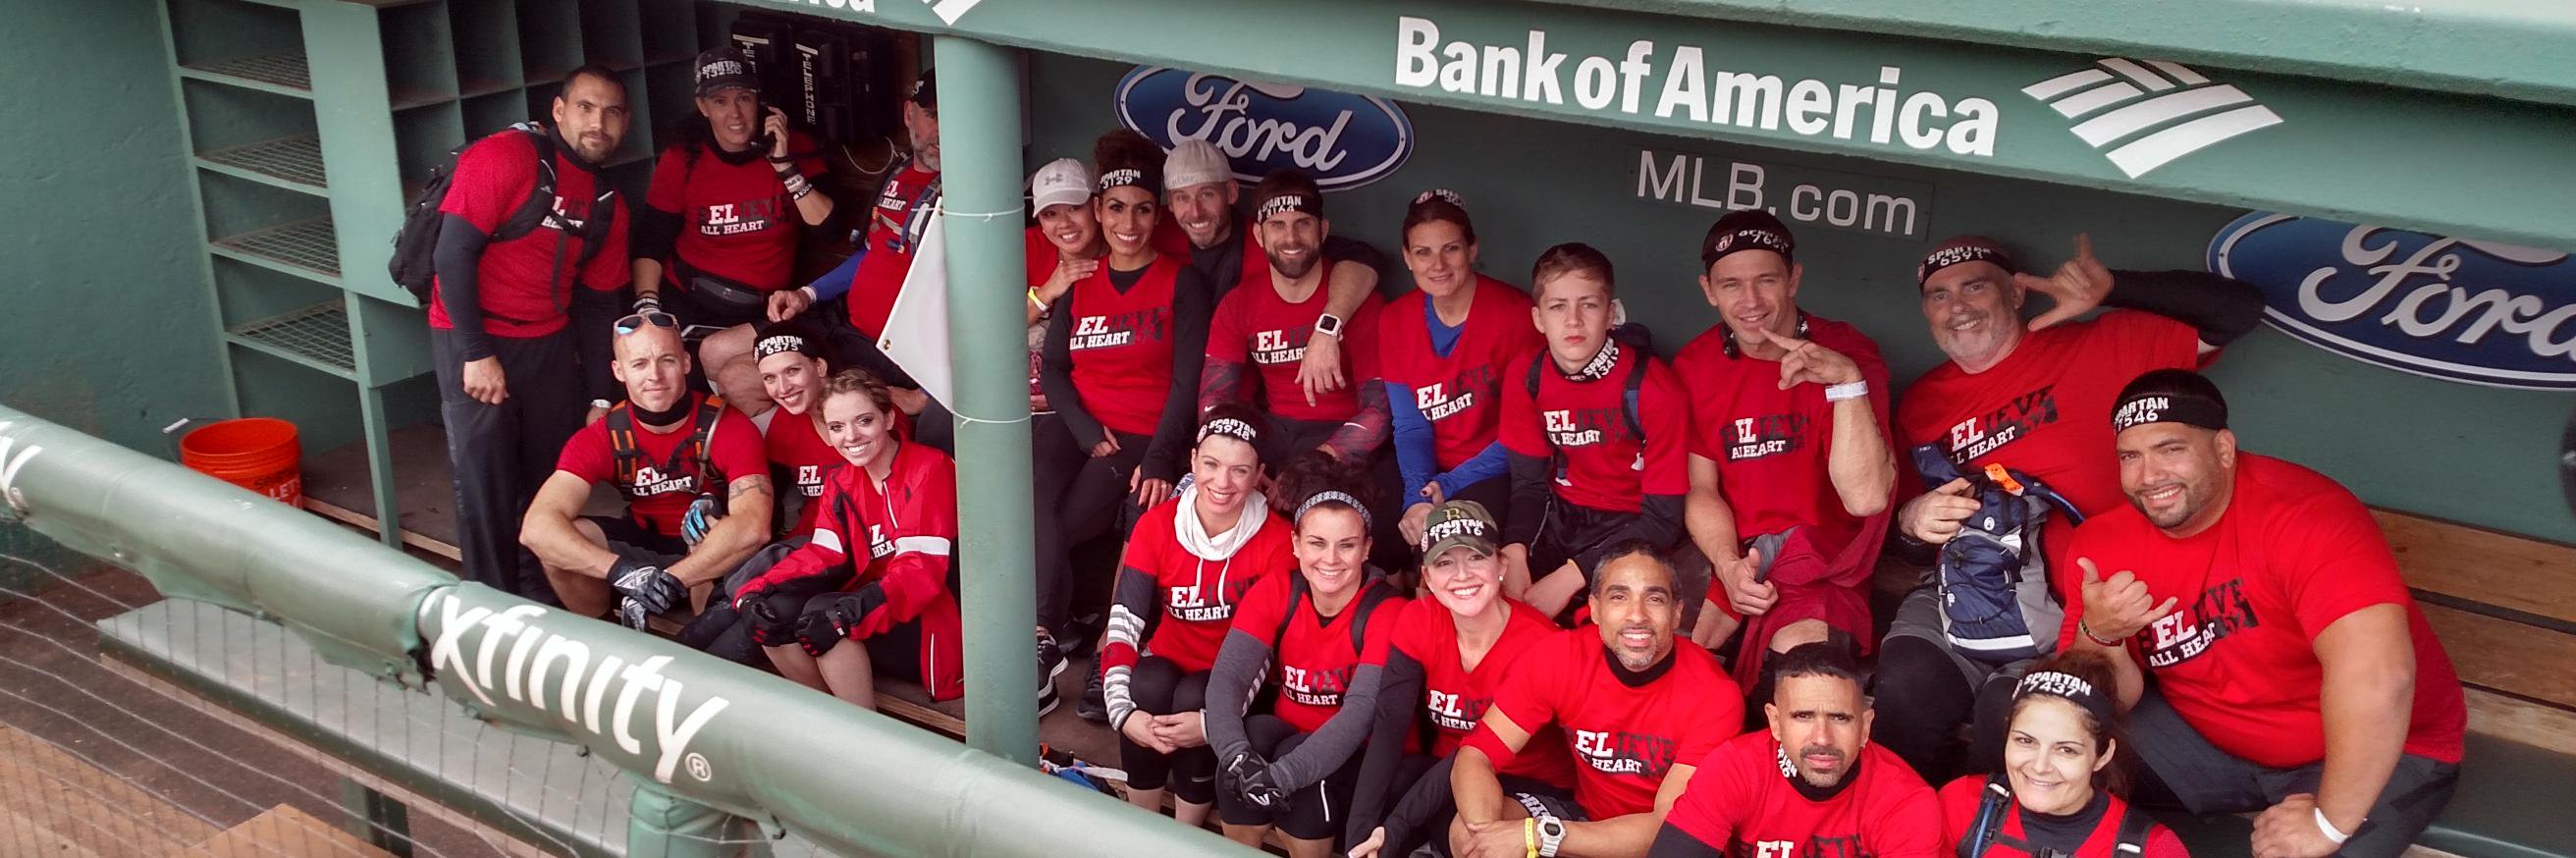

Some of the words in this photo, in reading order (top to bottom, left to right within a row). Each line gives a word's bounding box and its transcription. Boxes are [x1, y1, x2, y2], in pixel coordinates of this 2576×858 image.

[1395, 16, 1569, 106] Bank
[1573, 40, 1653, 113] of
[1655, 45, 1999, 157] America
[1167, 72, 1353, 172] Ford
[1100, 169, 1141, 185] SPARTAN
[1637, 150, 1916, 236] MLB.com
[700, 225, 720, 236] ALL
[724, 220, 764, 235] HEART
[759, 335, 803, 351] SPARTAN
[766, 343, 799, 355] 6575
[1086, 331, 1130, 349] HEART
[1270, 348, 1308, 364] HEAR
[1430, 393, 1473, 420] HEART
[2115, 398, 2169, 424] SPARTAN
[1208, 418, 1257, 438] SPARTAN
[1214, 424, 1250, 441] 3948
[1561, 429, 1600, 446] HEART
[1968, 426, 2015, 459] HEART
[1429, 518, 1484, 537] SPARTAN
[872, 541, 895, 559] HEA
[1185, 605, 1231, 621] HEART
[2150, 649, 2179, 668] ALL
[431, 595, 729, 784] xfinity
[2023, 671, 2092, 696] SPARTAN
[2027, 680, 2078, 697] 7437
[1297, 692, 1338, 705] HEART
[1591, 757, 1642, 774] HEART
